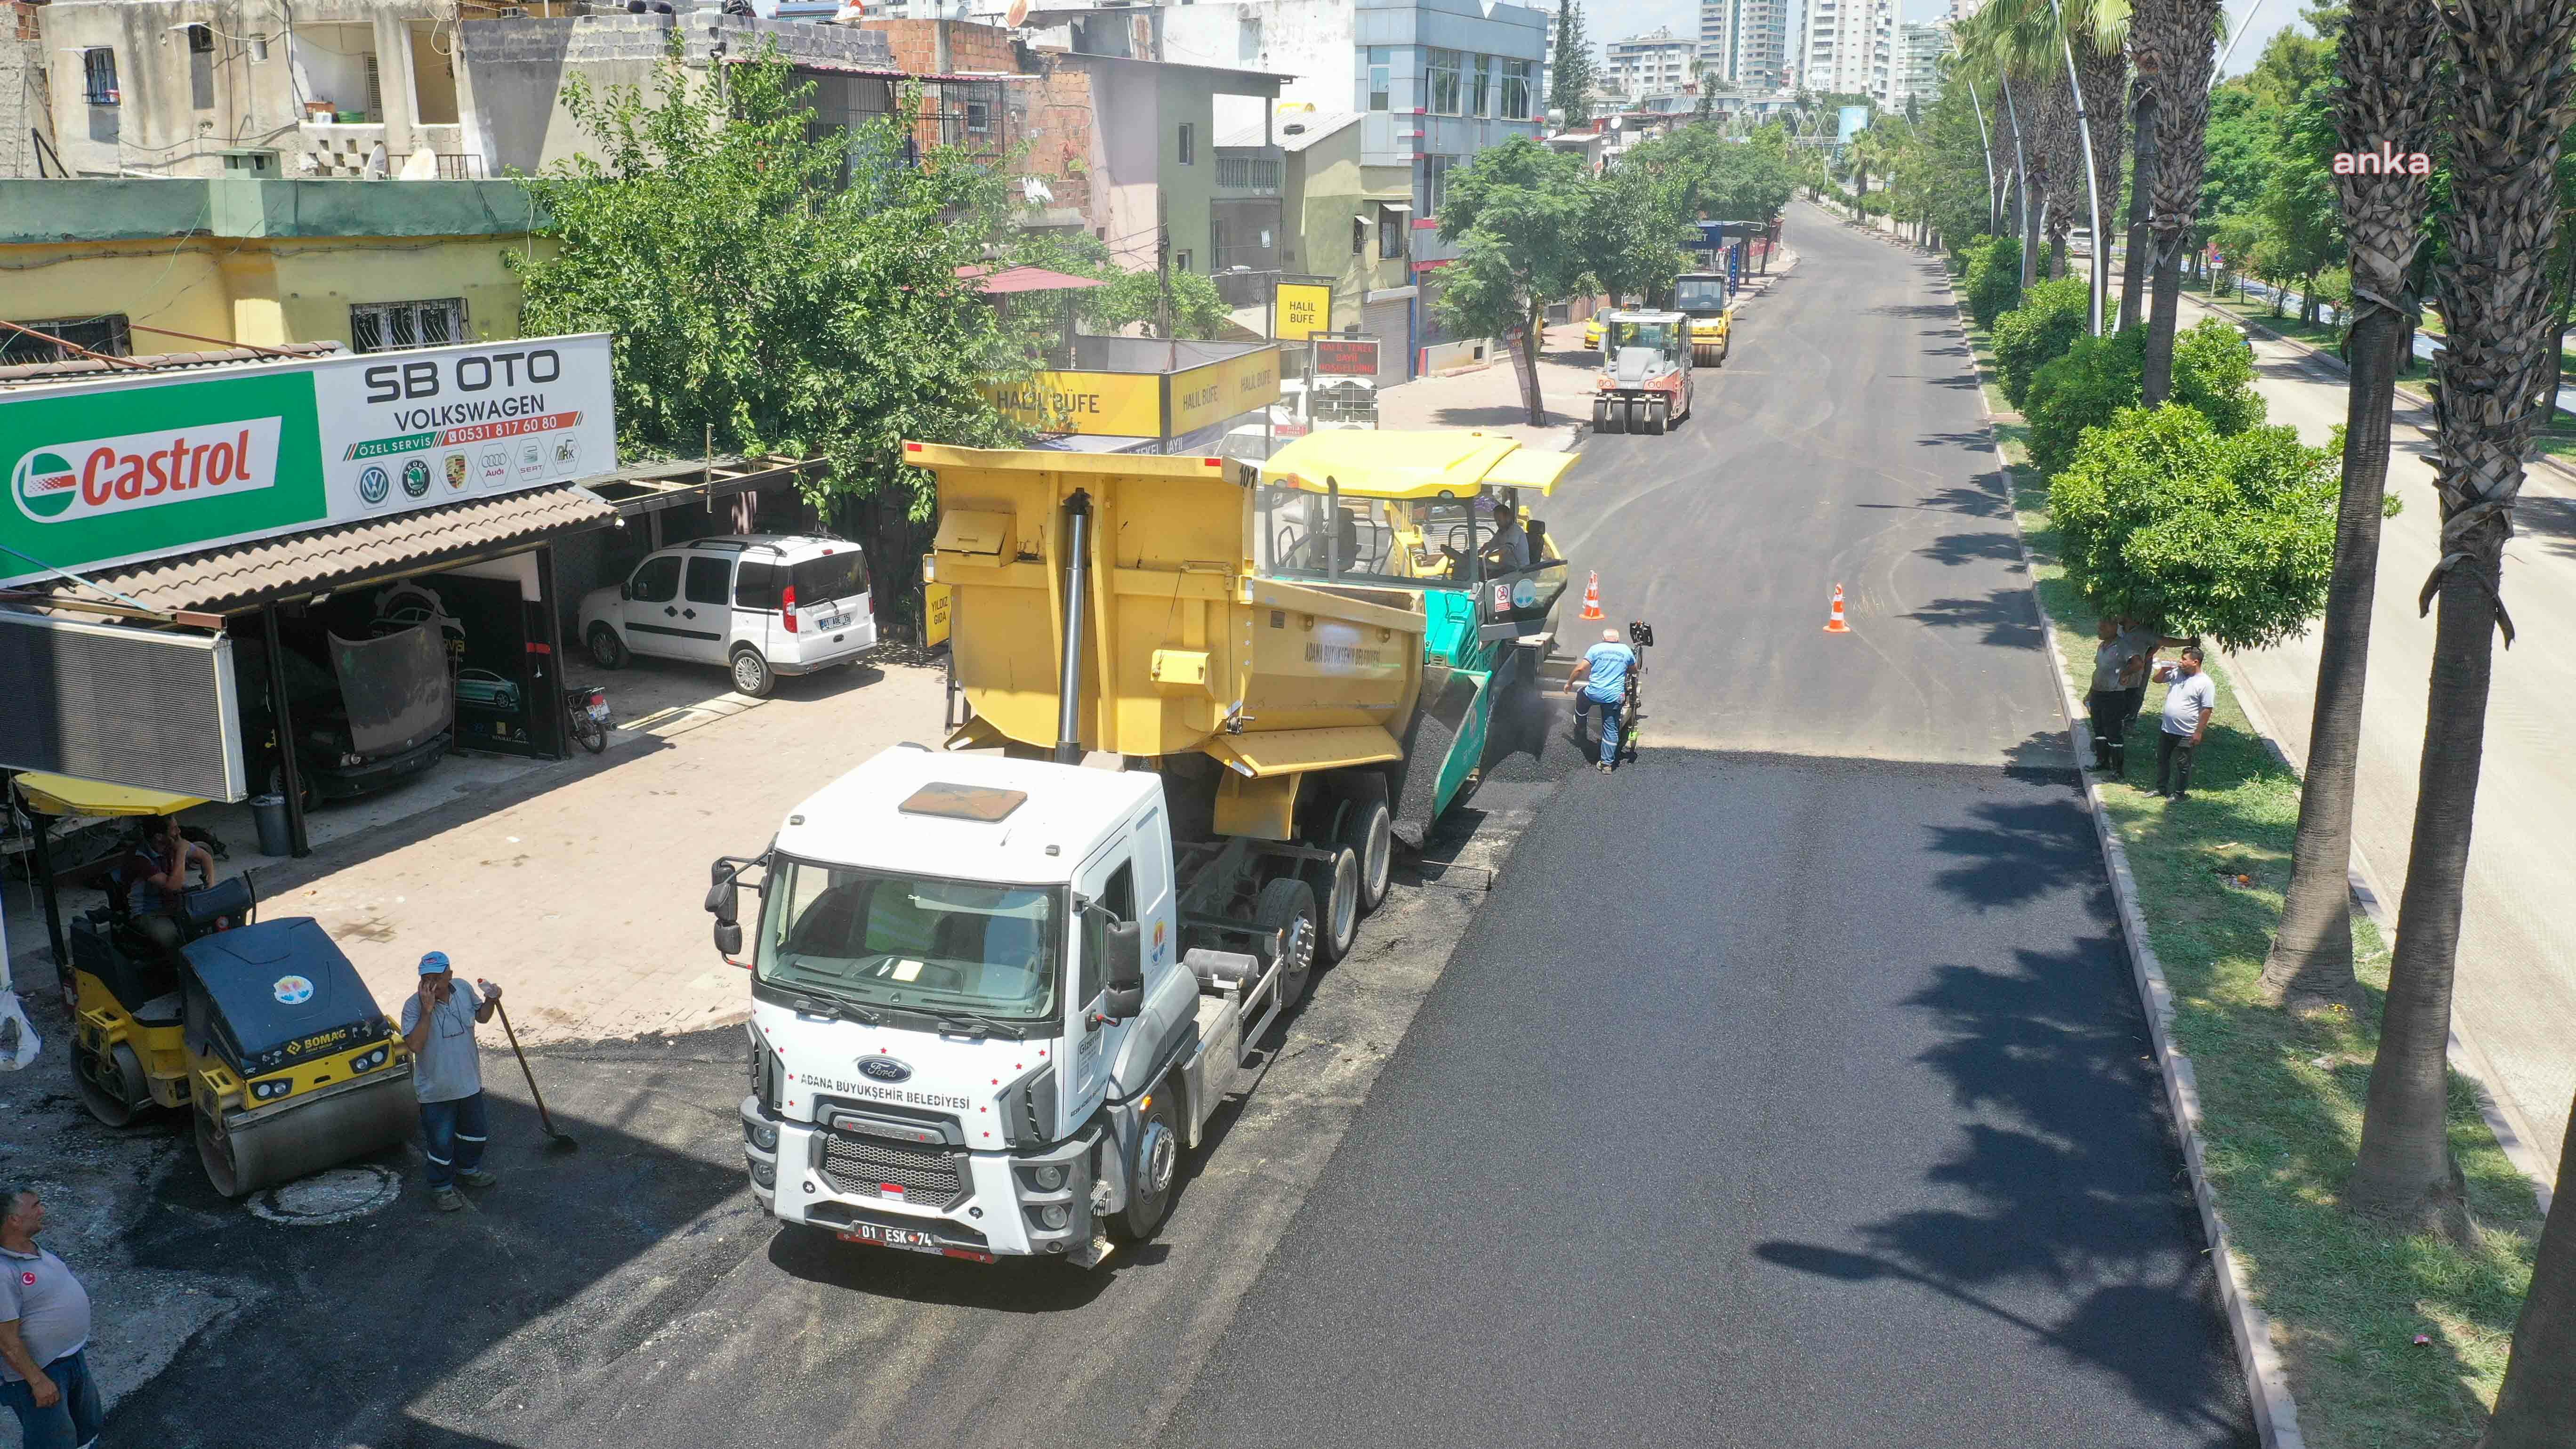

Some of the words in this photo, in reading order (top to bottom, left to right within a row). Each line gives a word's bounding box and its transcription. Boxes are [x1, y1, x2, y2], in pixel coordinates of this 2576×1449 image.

[1289, 299, 1316, 311] HALİL
[1290, 311, 1314, 324] BÜFE
[365, 361, 439, 403] SB
[456, 349, 560, 392] OTO
[1183, 387, 1201, 411] HALİL
[394, 394, 544, 431] VOLKSWAGEN
[459, 426, 491, 442] 0531
[496, 423, 519, 436] 817
[523, 419, 538, 432] 60
[542, 416, 557, 428] 80
[359, 444, 388, 456] ÖZEL
[392, 435, 431, 451] SERVİS
[82, 429, 250, 506] Castrol
[485, 468, 504, 477] Audi
[520, 465, 543, 473] SEAT
[1239, 464, 1257, 489] 101
[931, 596, 948, 612] YILDIZ
[934, 611, 946, 625] GIDA
[305, 1029, 346, 1049] BOMAG
[868, 1062, 897, 1079] Ford
[801, 1073, 833, 1090] ADANA
[836, 1080, 903, 1102] BÜYÜKŞEHİR
[906, 1091, 970, 1110] BELEDİYESİ
[861, 1225, 876, 1239] 01
[885, 1228, 907, 1244] ESK
[917, 1232, 932, 1247] 74
